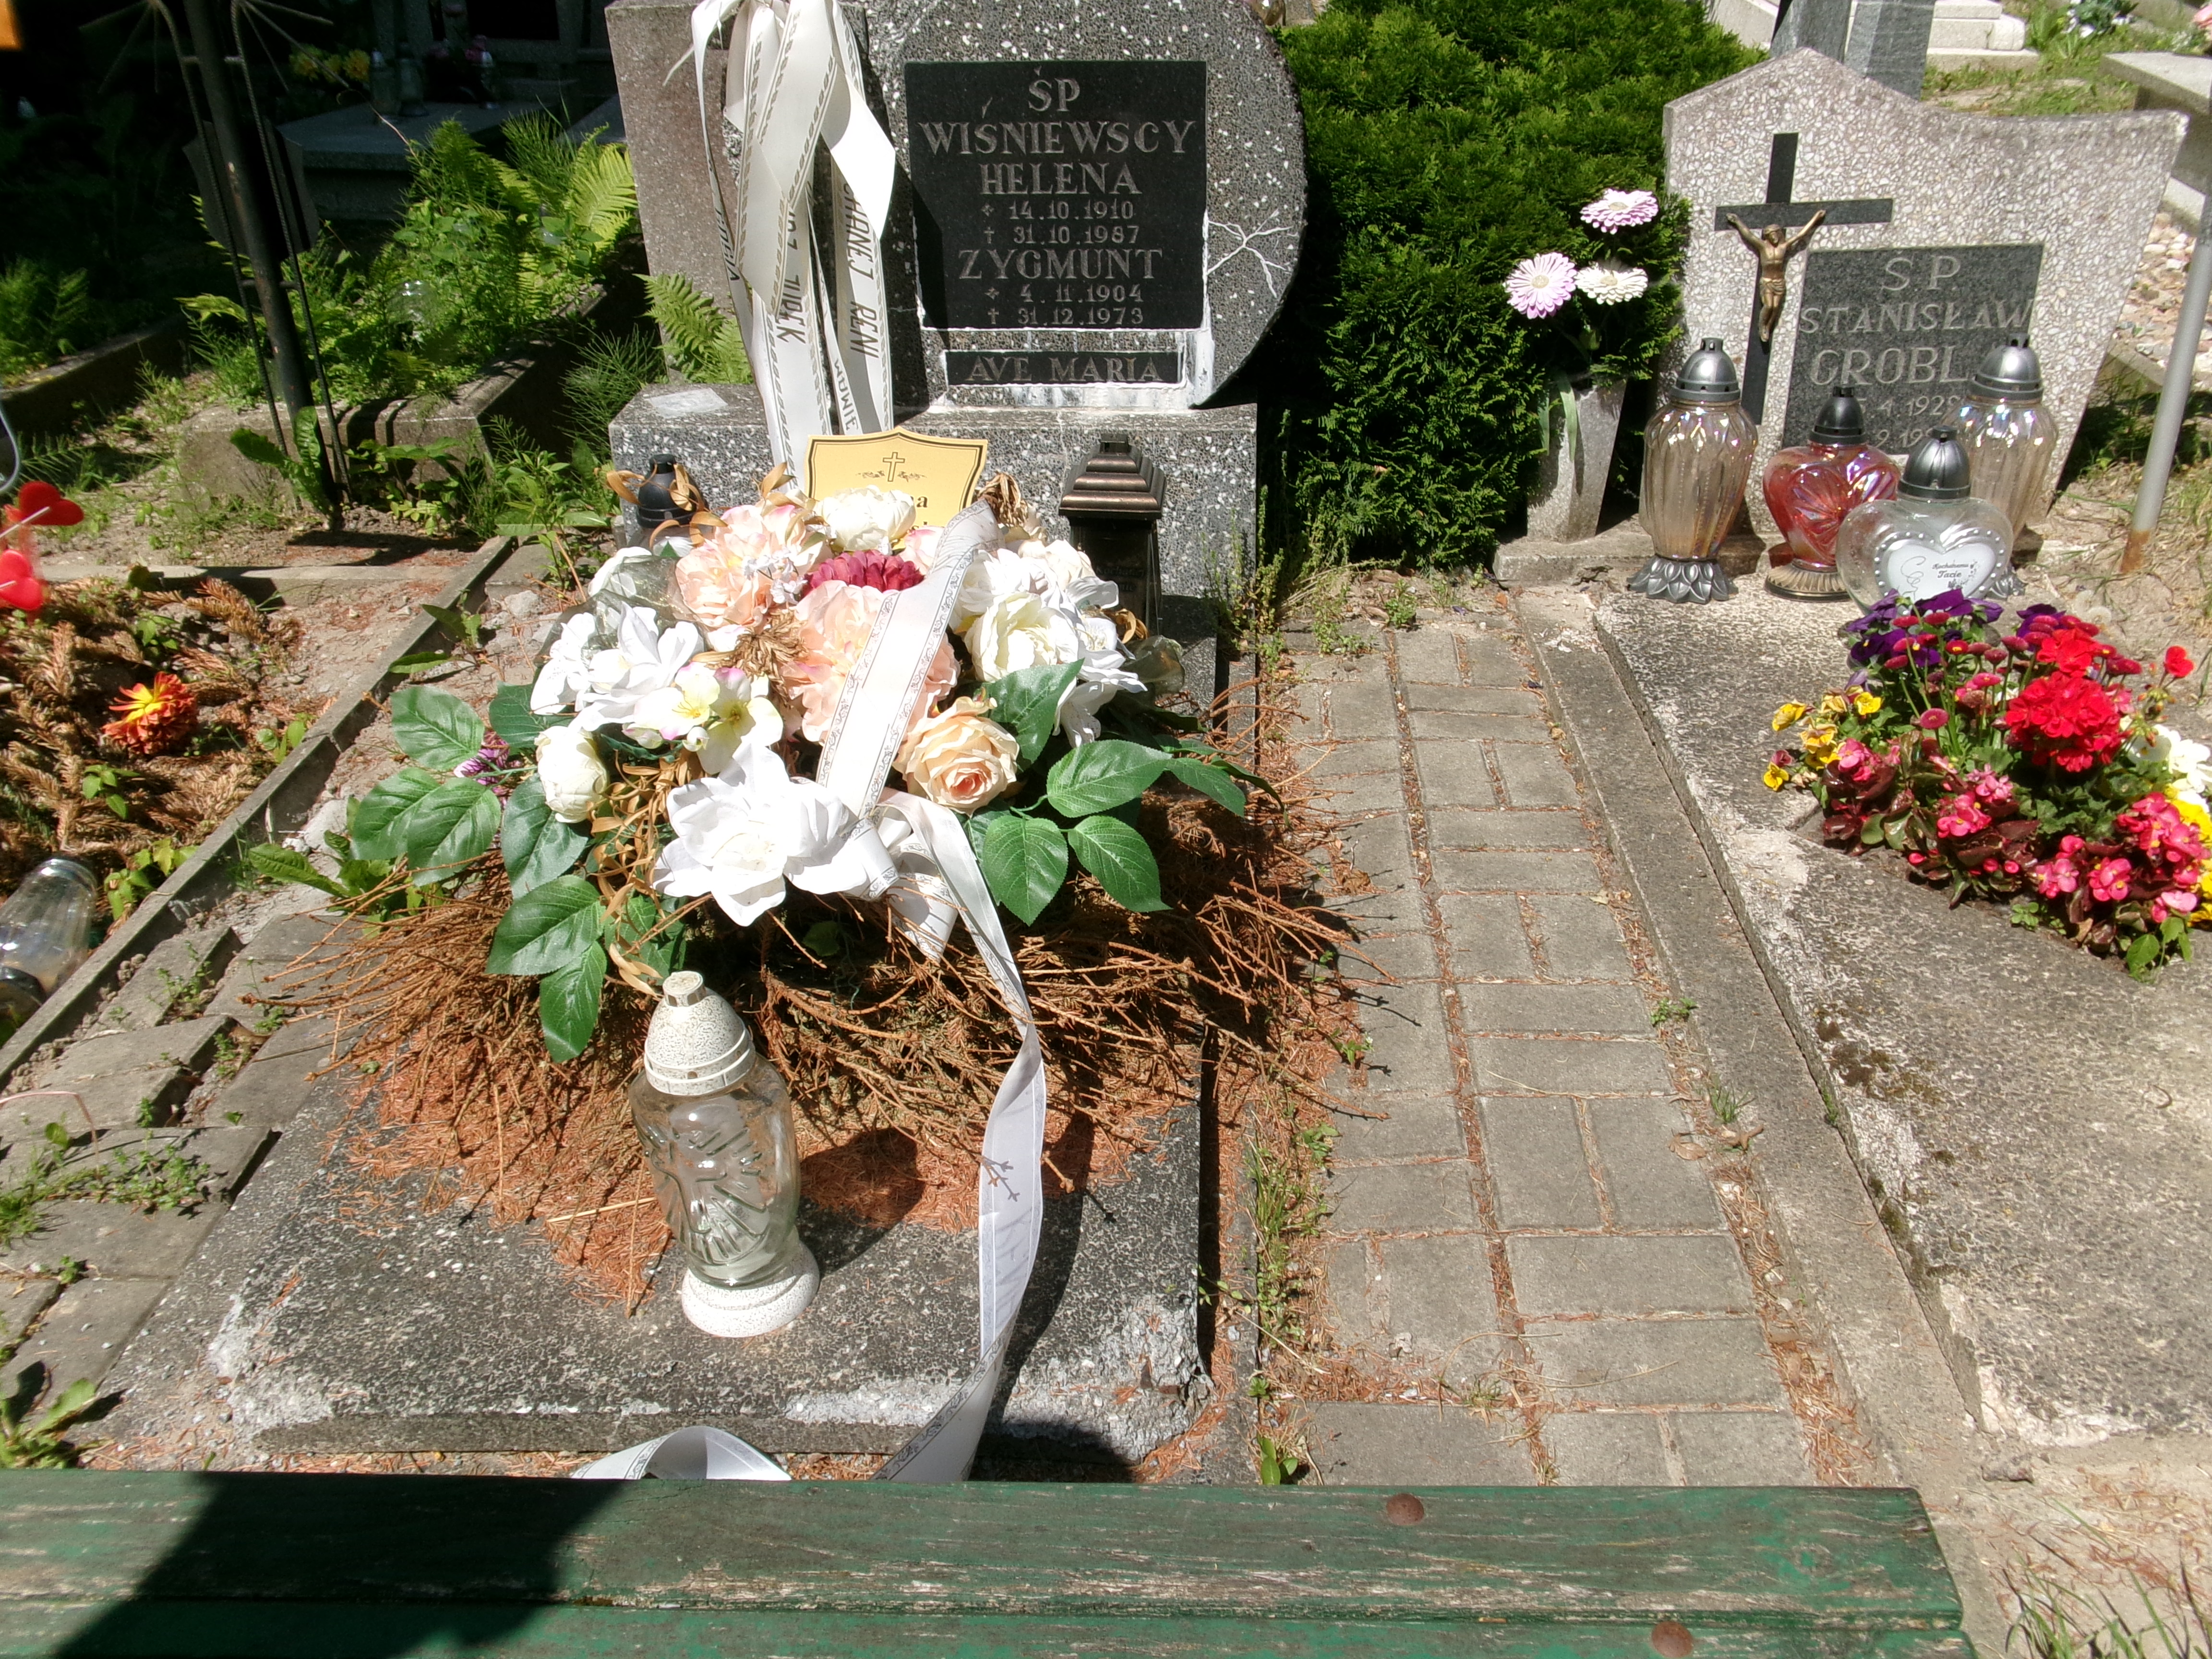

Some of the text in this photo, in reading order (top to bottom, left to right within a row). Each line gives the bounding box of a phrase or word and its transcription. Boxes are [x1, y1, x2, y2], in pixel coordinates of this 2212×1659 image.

[1028, 66, 1080, 111] ŚP
[918, 97, 1196, 155] WIŚNIEWSCY
[978, 162, 1142, 194] HELENA
[1009, 198, 1133, 220] 14.10.1910
[1013, 224, 1139, 244] 31.10.1987
[958, 249, 1163, 279] ZYGMUNT
[850, 300, 879, 359] RENI
[1017, 307, 1143, 325] 31.12.1973
[1798, 299, 2034, 334] STANISŁAW
[965, 356, 1163, 381] AVE MARIA
[1809, 346, 1970, 385] GROBL
